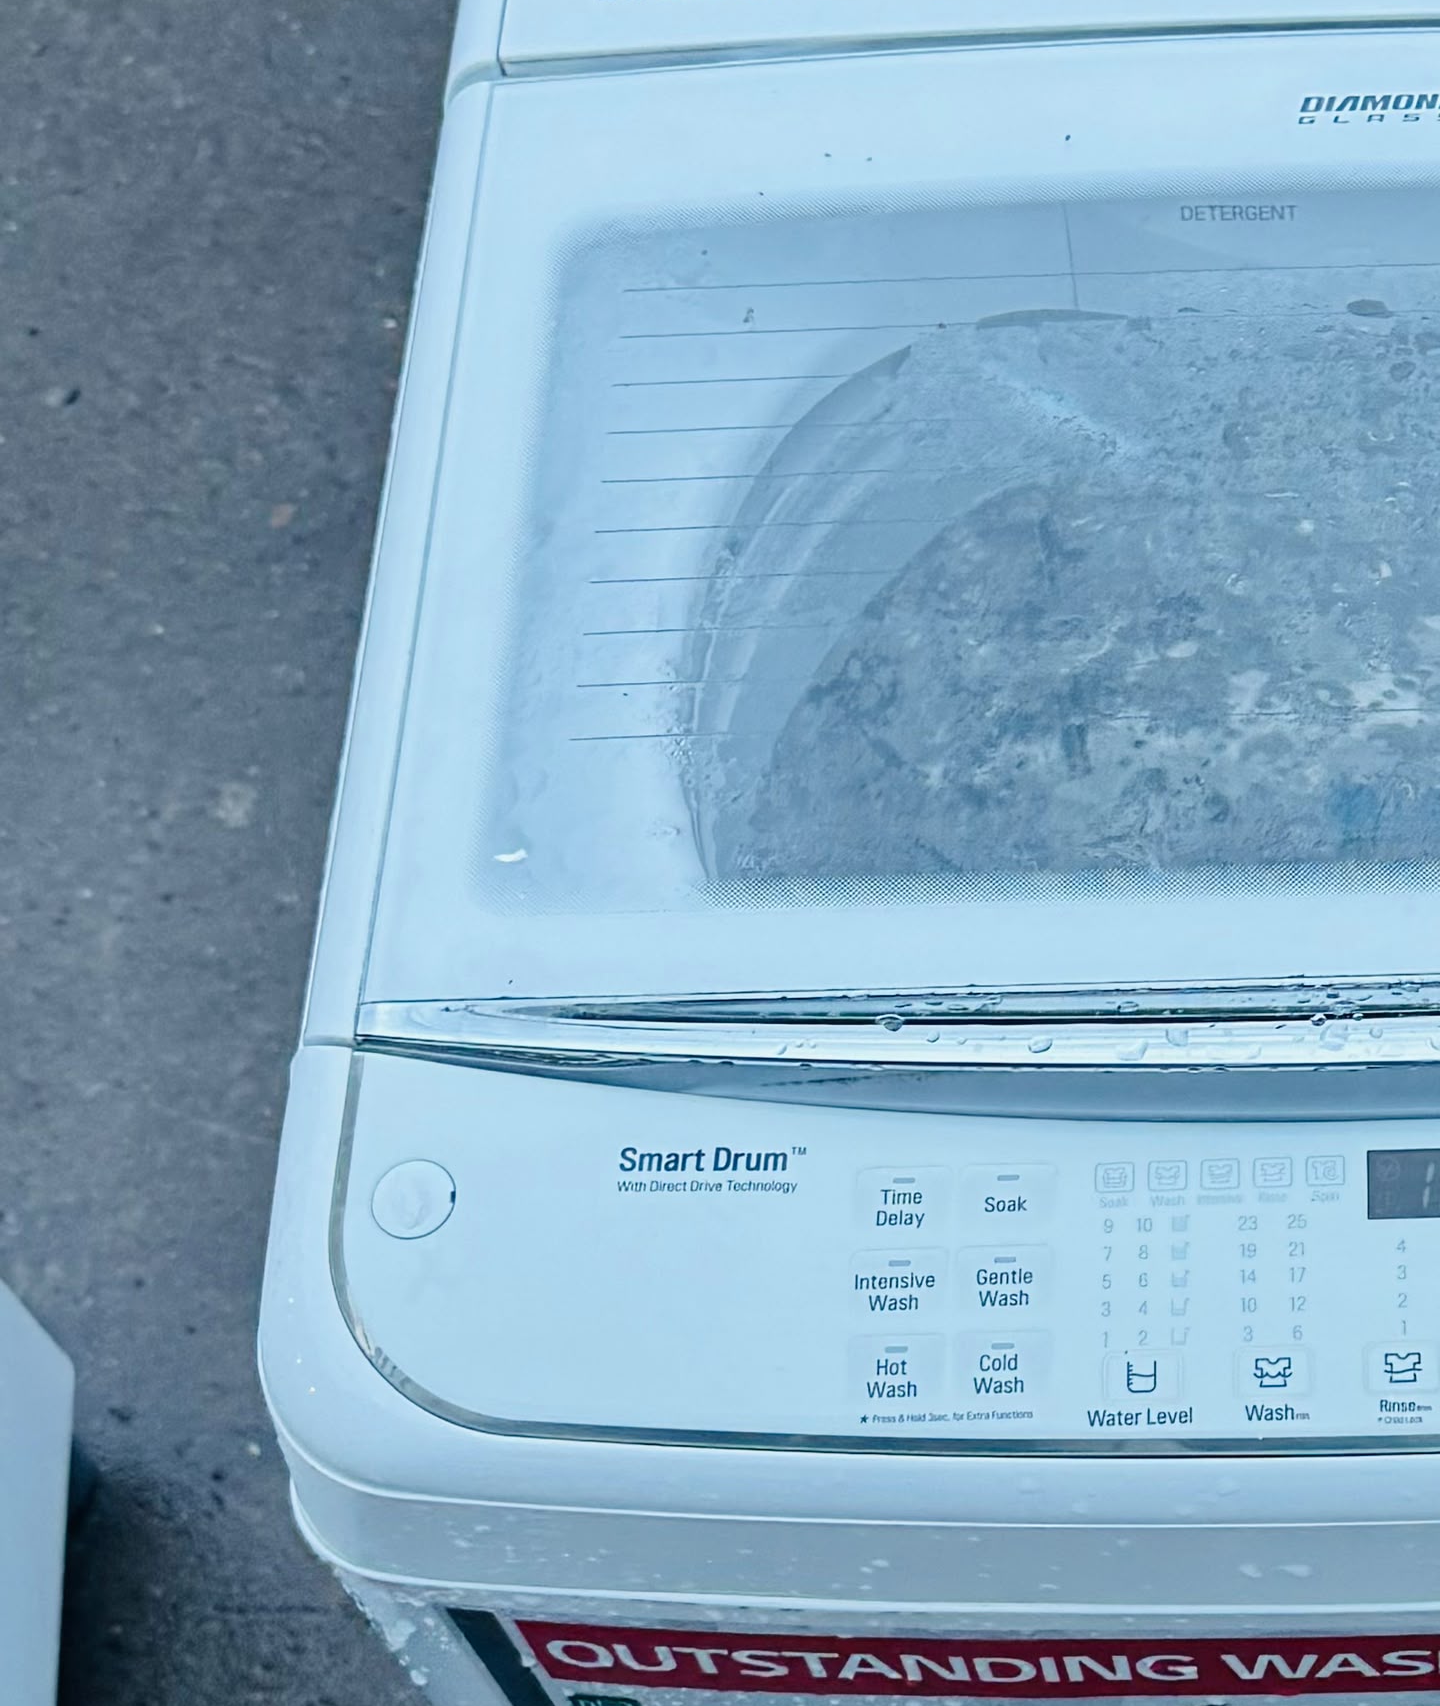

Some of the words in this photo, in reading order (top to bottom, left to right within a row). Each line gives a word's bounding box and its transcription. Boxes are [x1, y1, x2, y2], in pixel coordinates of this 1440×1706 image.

[1180, 204, 1297, 221] DETERGENT
[619, 1147, 705, 1172] Smart
[618, 1181, 646, 1192] With
[649, 1180, 687, 1192] Direct
[690, 1180, 722, 1192] Drive
[727, 1180, 798, 1193] Technology
[880, 1189, 923, 1205] Time
[984, 1196, 1027, 1212] Soak
[876, 1210, 925, 1228] Delay
[1103, 1218, 1114, 1233] 9
[1136, 1217, 1153, 1233] 10
[1238, 1215, 1258, 1231] 23
[1287, 1214, 1307, 1230] 25
[1103, 1245, 1112, 1261] 7
[1138, 1245, 1149, 1260] 8
[1240, 1243, 1257, 1258] 19
[1288, 1241, 1305, 1257] 21
[1396, 1238, 1406, 1253] 4
[976, 1268, 1033, 1285] Gentle
[1102, 1273, 1112, 1289] 5
[1138, 1272, 1148, 1287] 6
[1240, 1269, 1257, 1284] 14
[1289, 1267, 1307, 1283] 17
[1397, 1264, 1407, 1280] 3
[854, 1272, 935, 1290] Intensive
[868, 1294, 919, 1311] Wash
[978, 1290, 1029, 1307] Wash
[1241, 1297, 1257, 1313] 10
[1290, 1295, 1306, 1312] 12
[1398, 1293, 1408, 1308] 2
[1101, 1301, 1111, 1317] 3
[1138, 1300, 1148, 1315] 4
[1243, 1325, 1254, 1343] 3
[1292, 1324, 1303, 1341] 6
[1401, 1320, 1407, 1336] 1
[1103, 1331, 1109, 1348] 1
[1138, 1329, 1148, 1345] 2
[876, 1358, 908, 1376] Hot
[979, 1354, 1019, 1372] Cold
[866, 1381, 918, 1398] Wash
[973, 1376, 1024, 1394] Wash
[1245, 1403, 1296, 1422] Wash
[1380, 1399, 1415, 1412] Rinse
[967, 1411, 990, 1421] Extra
[992, 1409, 1034, 1420] Functions
[1087, 1409, 1142, 1427] Water
[1147, 1406, 1193, 1425] Level
[545, 1638, 1198, 1683] OUTSTANDING
